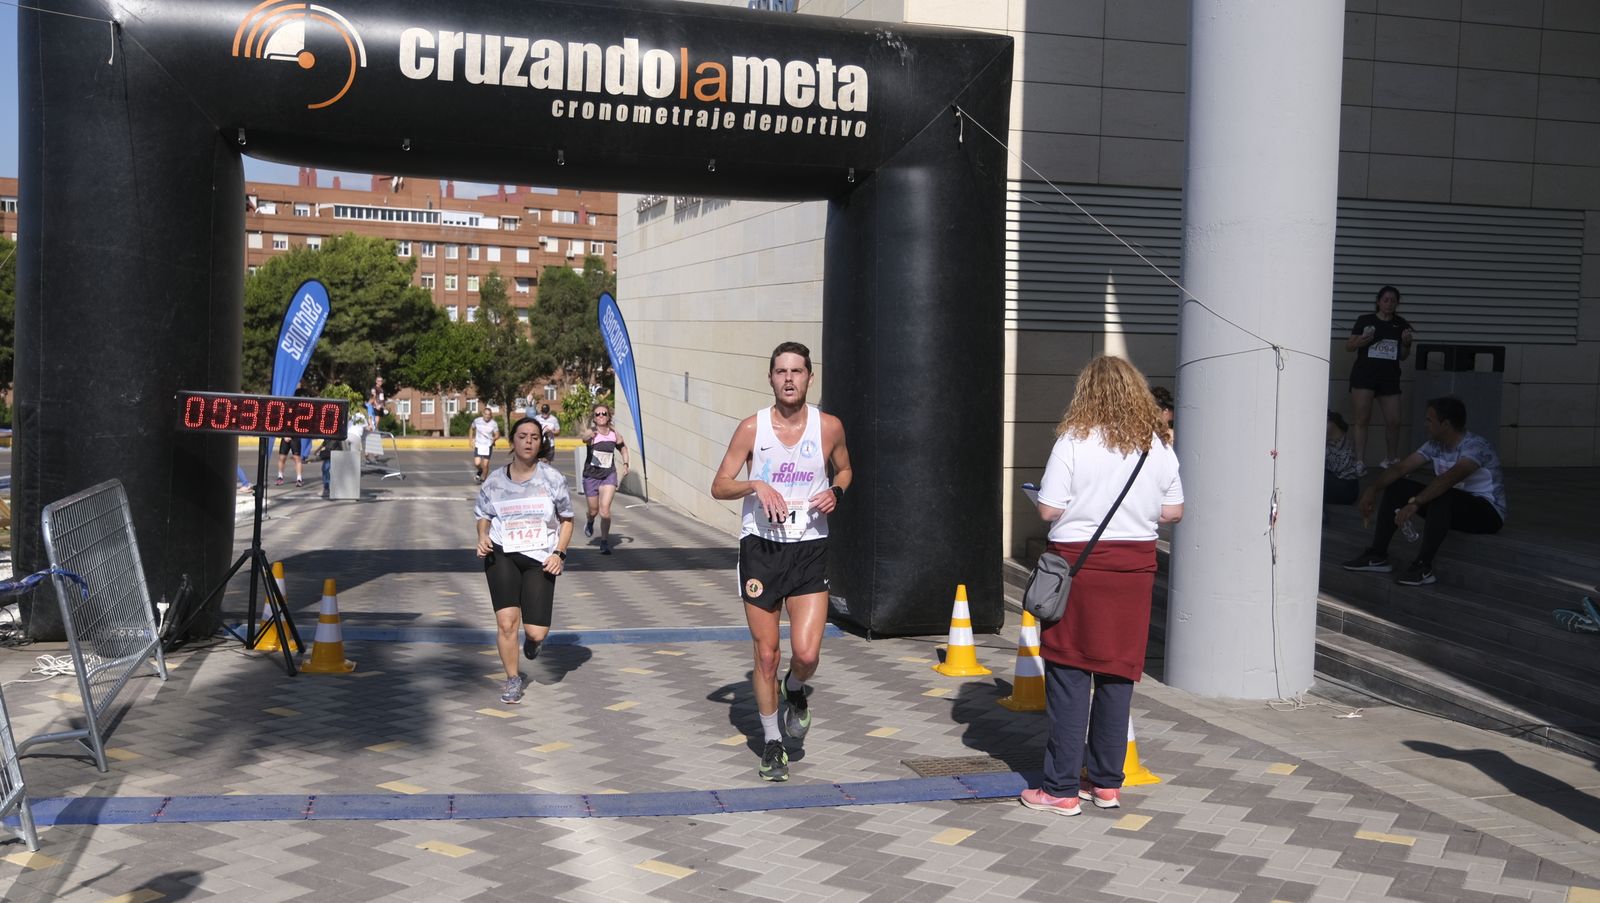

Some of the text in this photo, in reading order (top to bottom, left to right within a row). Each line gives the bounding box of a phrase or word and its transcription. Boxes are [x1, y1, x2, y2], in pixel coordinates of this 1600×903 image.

[551, 98, 867, 138] cronometraje deportivo
[184, 396, 340, 434] 00:30:20
[780, 462, 795, 473] GO
[508, 528, 542, 541] 1147
